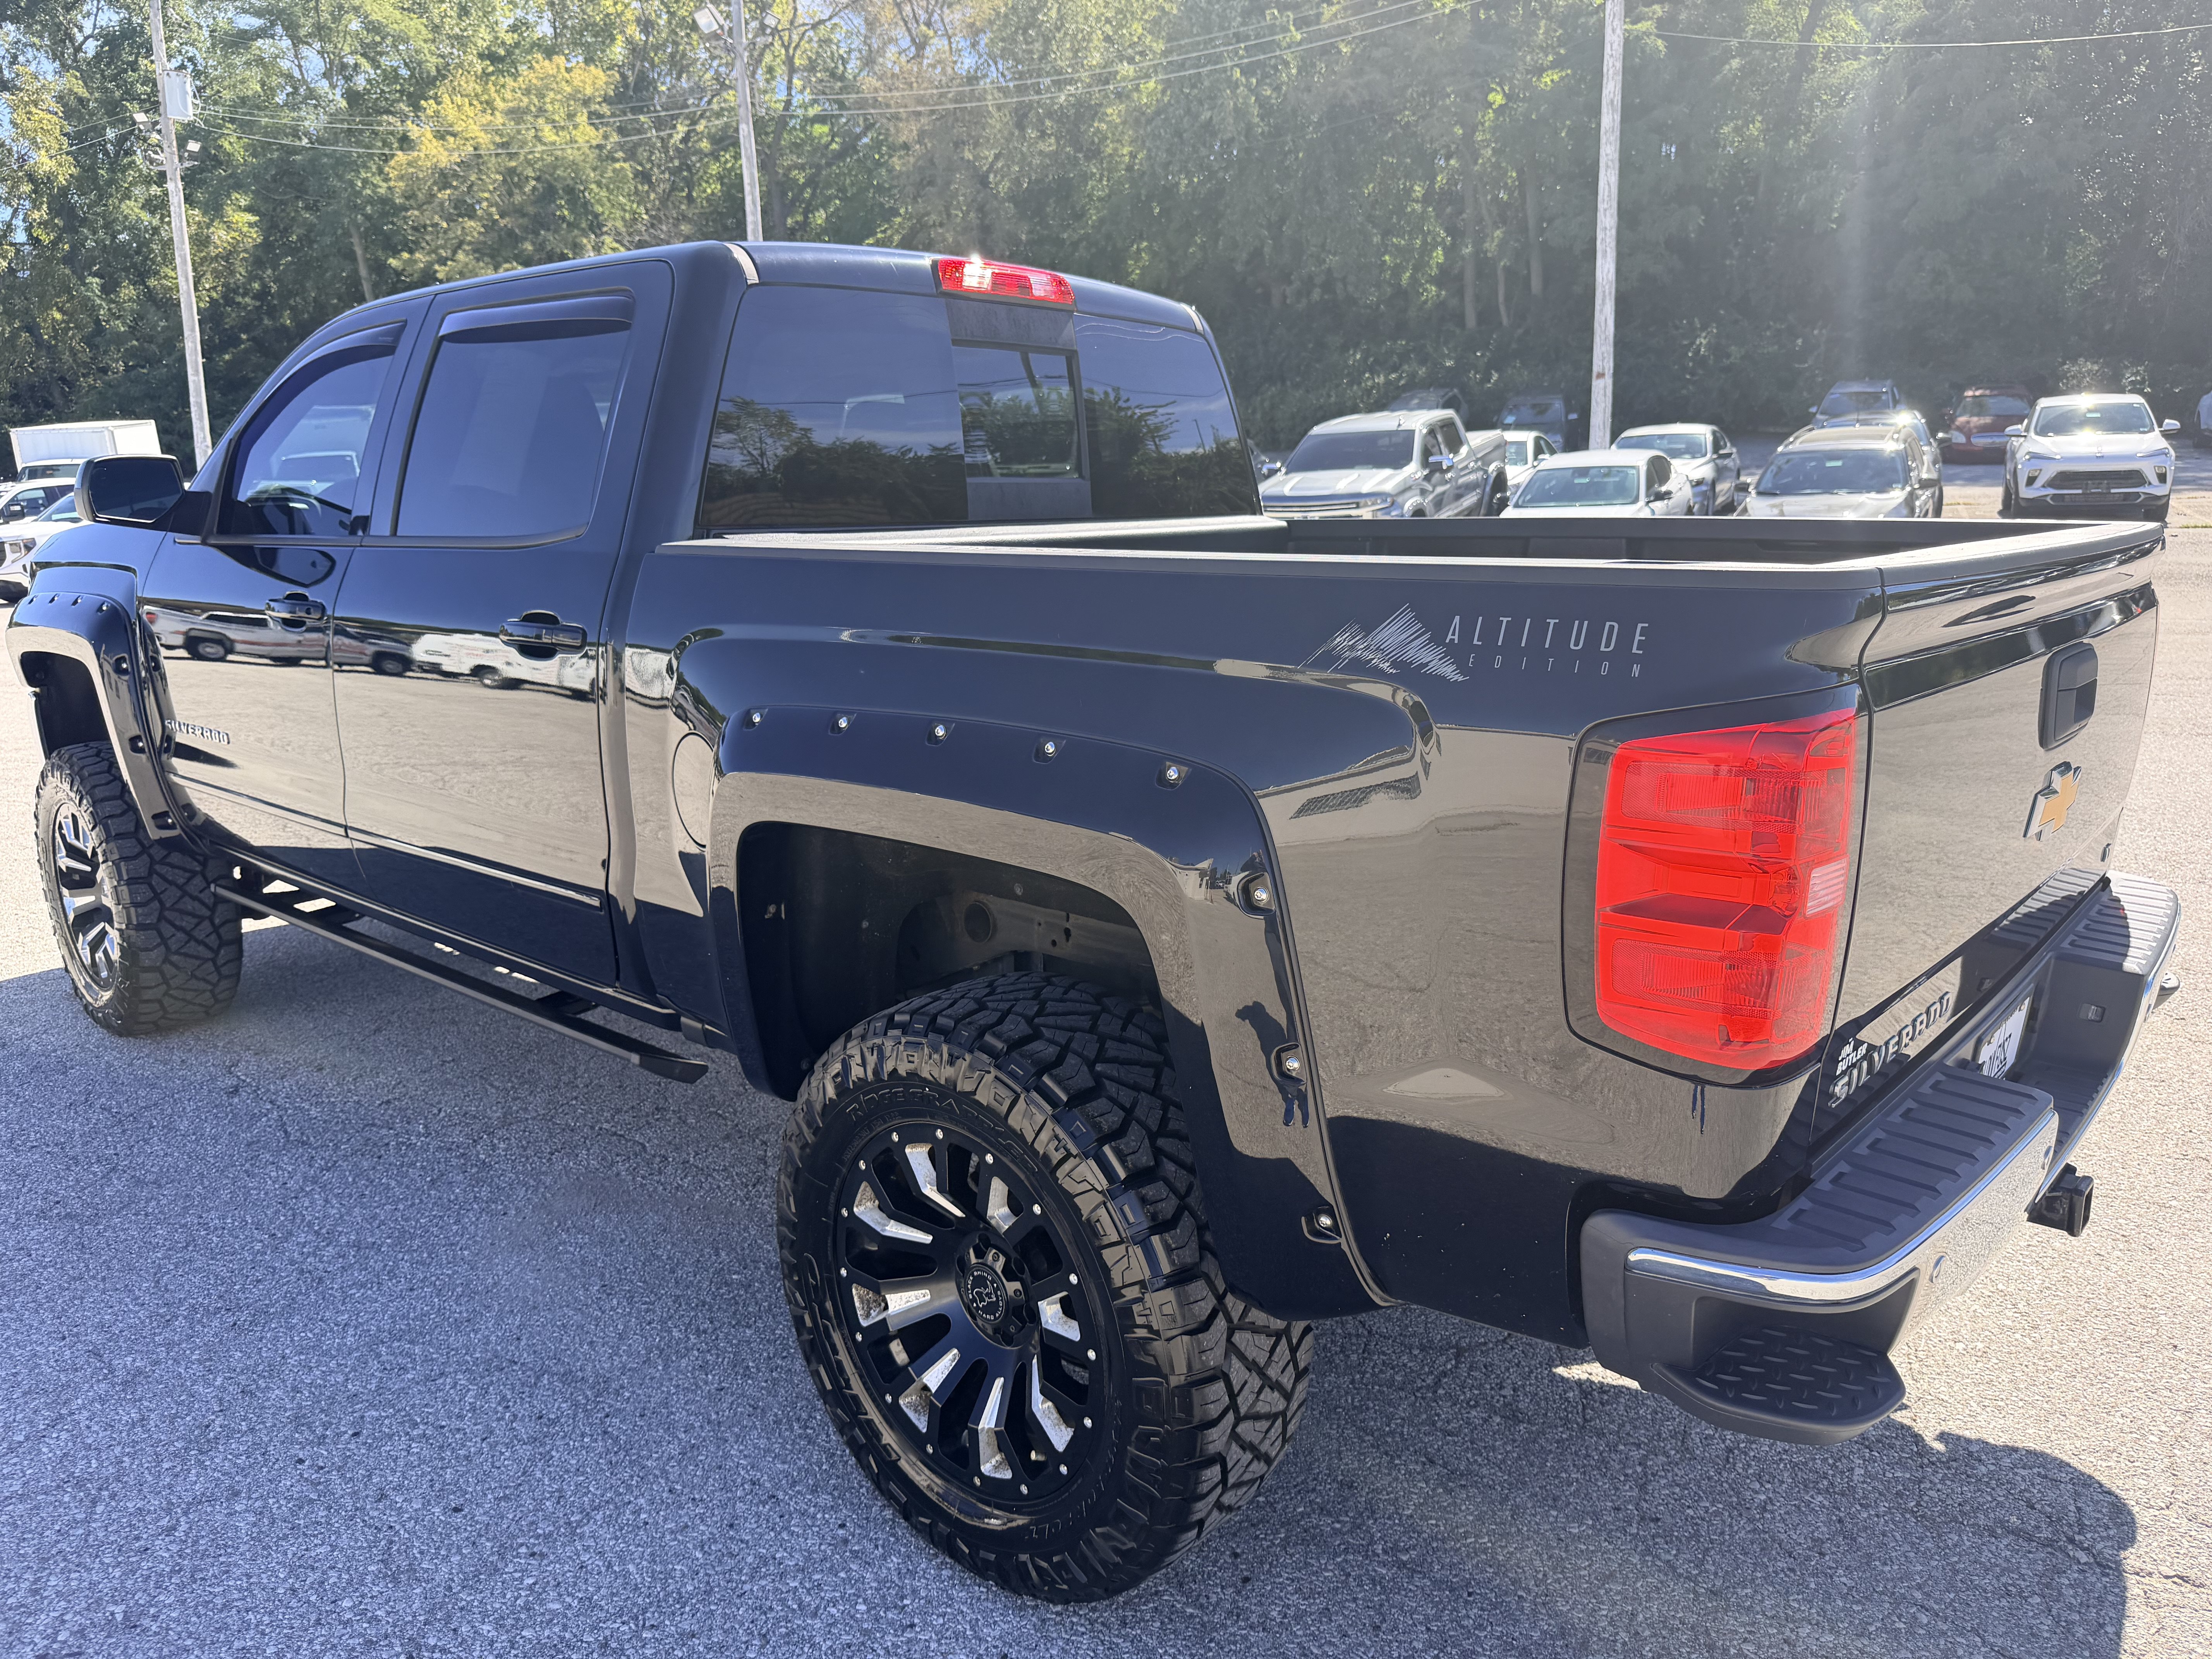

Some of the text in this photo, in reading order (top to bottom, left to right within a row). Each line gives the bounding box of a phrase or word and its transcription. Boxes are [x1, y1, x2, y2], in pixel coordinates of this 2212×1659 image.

[1445, 615, 1649, 654] ALTITUDE
[1468, 654, 1641, 678] EDITION
[165, 719, 230, 745] SILVERADO
[1828, 991, 1952, 1108] SILVERADO
[1836, 1042, 1868, 1076] BUTLER
[1838, 1040, 1854, 1061] JIM
[846, 1087, 905, 1121] RIDGE
[974, 1271, 991, 1280] RHINO
[979, 1310, 994, 1319] HARD
